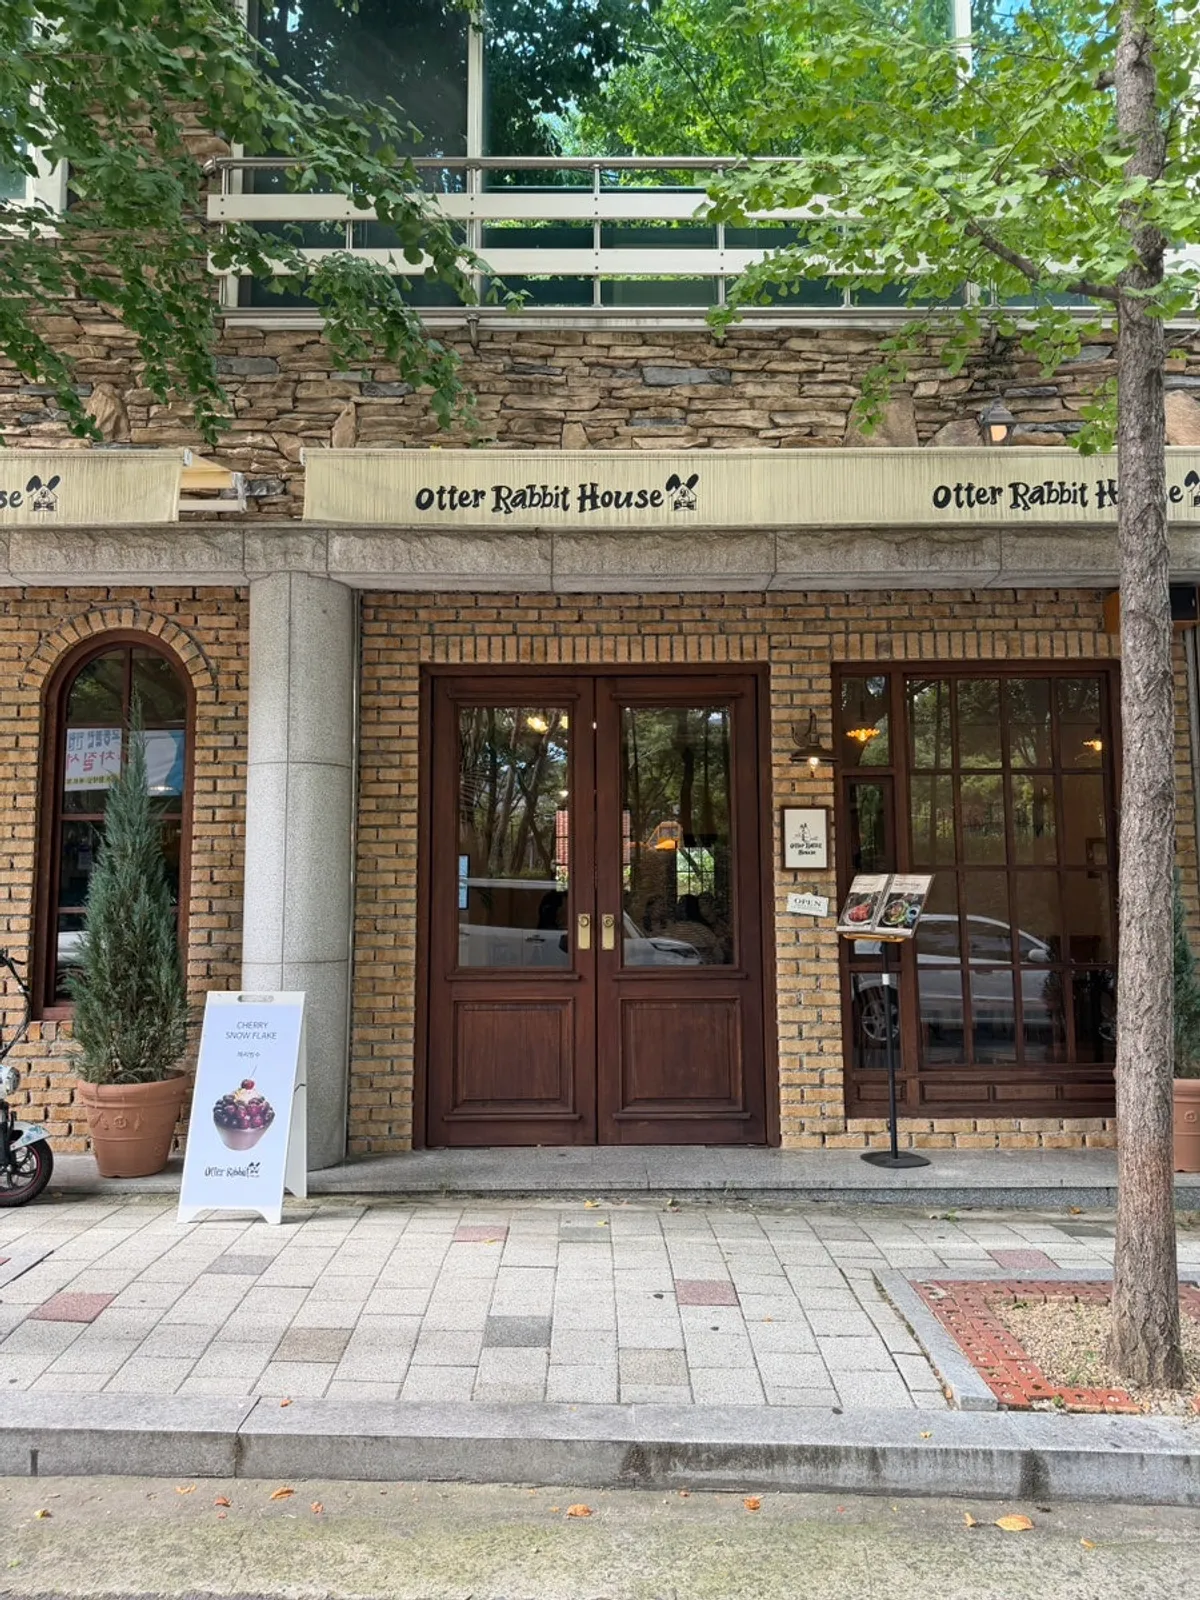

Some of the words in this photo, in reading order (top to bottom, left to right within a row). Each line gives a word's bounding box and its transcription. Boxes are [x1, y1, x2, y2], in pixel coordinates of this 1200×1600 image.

[415, 485, 486, 511] Otter
[491, 484, 571, 514] Rabbit
[577, 482, 664, 513] House
[933, 482, 1003, 509] Otter
[1008, 481, 1089, 511] Rabbit
[794, 898, 821, 907] OPEN
[236, 1021, 268, 1029] CHERRY
[225, 1031, 251, 1040] SNOW
[252, 1031, 278, 1040] FLAKE
